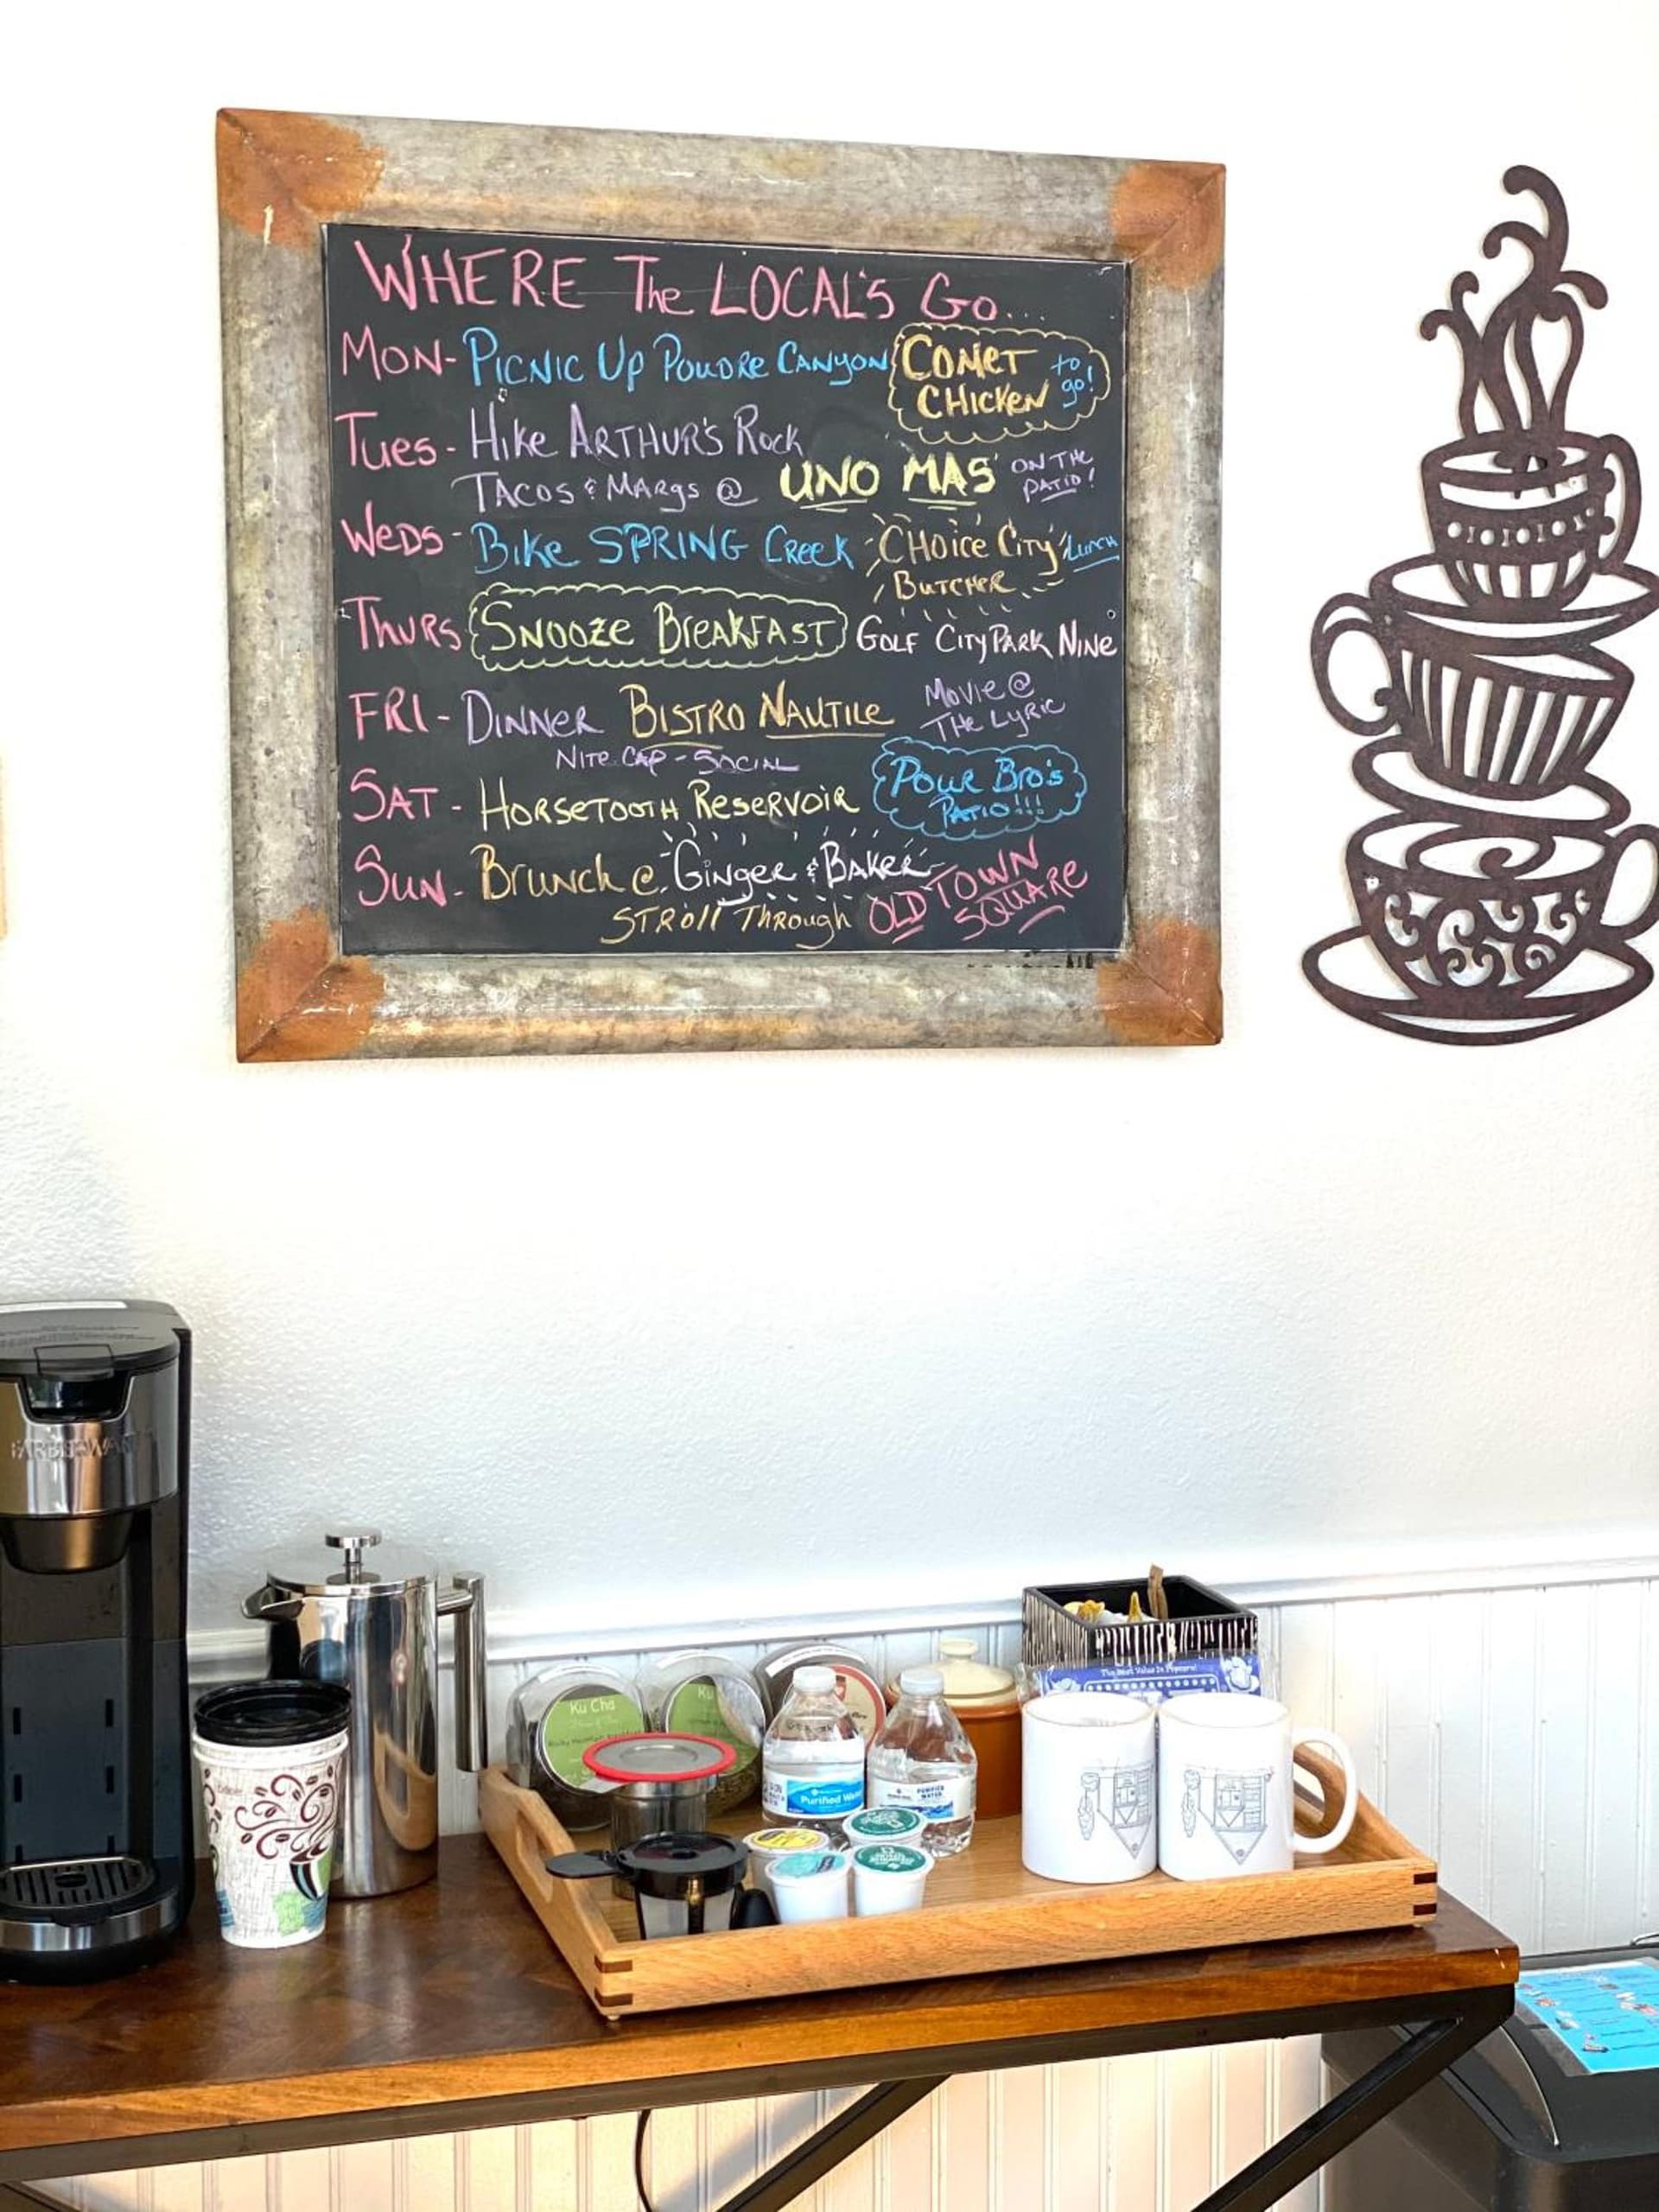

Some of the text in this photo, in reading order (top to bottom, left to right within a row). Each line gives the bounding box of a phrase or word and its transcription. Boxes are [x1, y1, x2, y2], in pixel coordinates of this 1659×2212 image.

[354, 235, 587, 310] WHERE
[710, 262, 895, 321] LOCAL'S
[450, 472, 575, 513] TACOS
[715, 476, 759, 506] @
[779, 452, 880, 502] UNO
[1011, 453, 1045, 474] ON
[589, 522, 749, 565] SPRING
[856, 613, 920, 654] GOLF
[1007, 671, 1035, 699] @
[620, 683, 745, 739] BISTRO
[868, 888, 927, 935] OLD
[569, 1697, 616, 1715] Ku Cha
[800, 1795, 841, 1806] Purified
